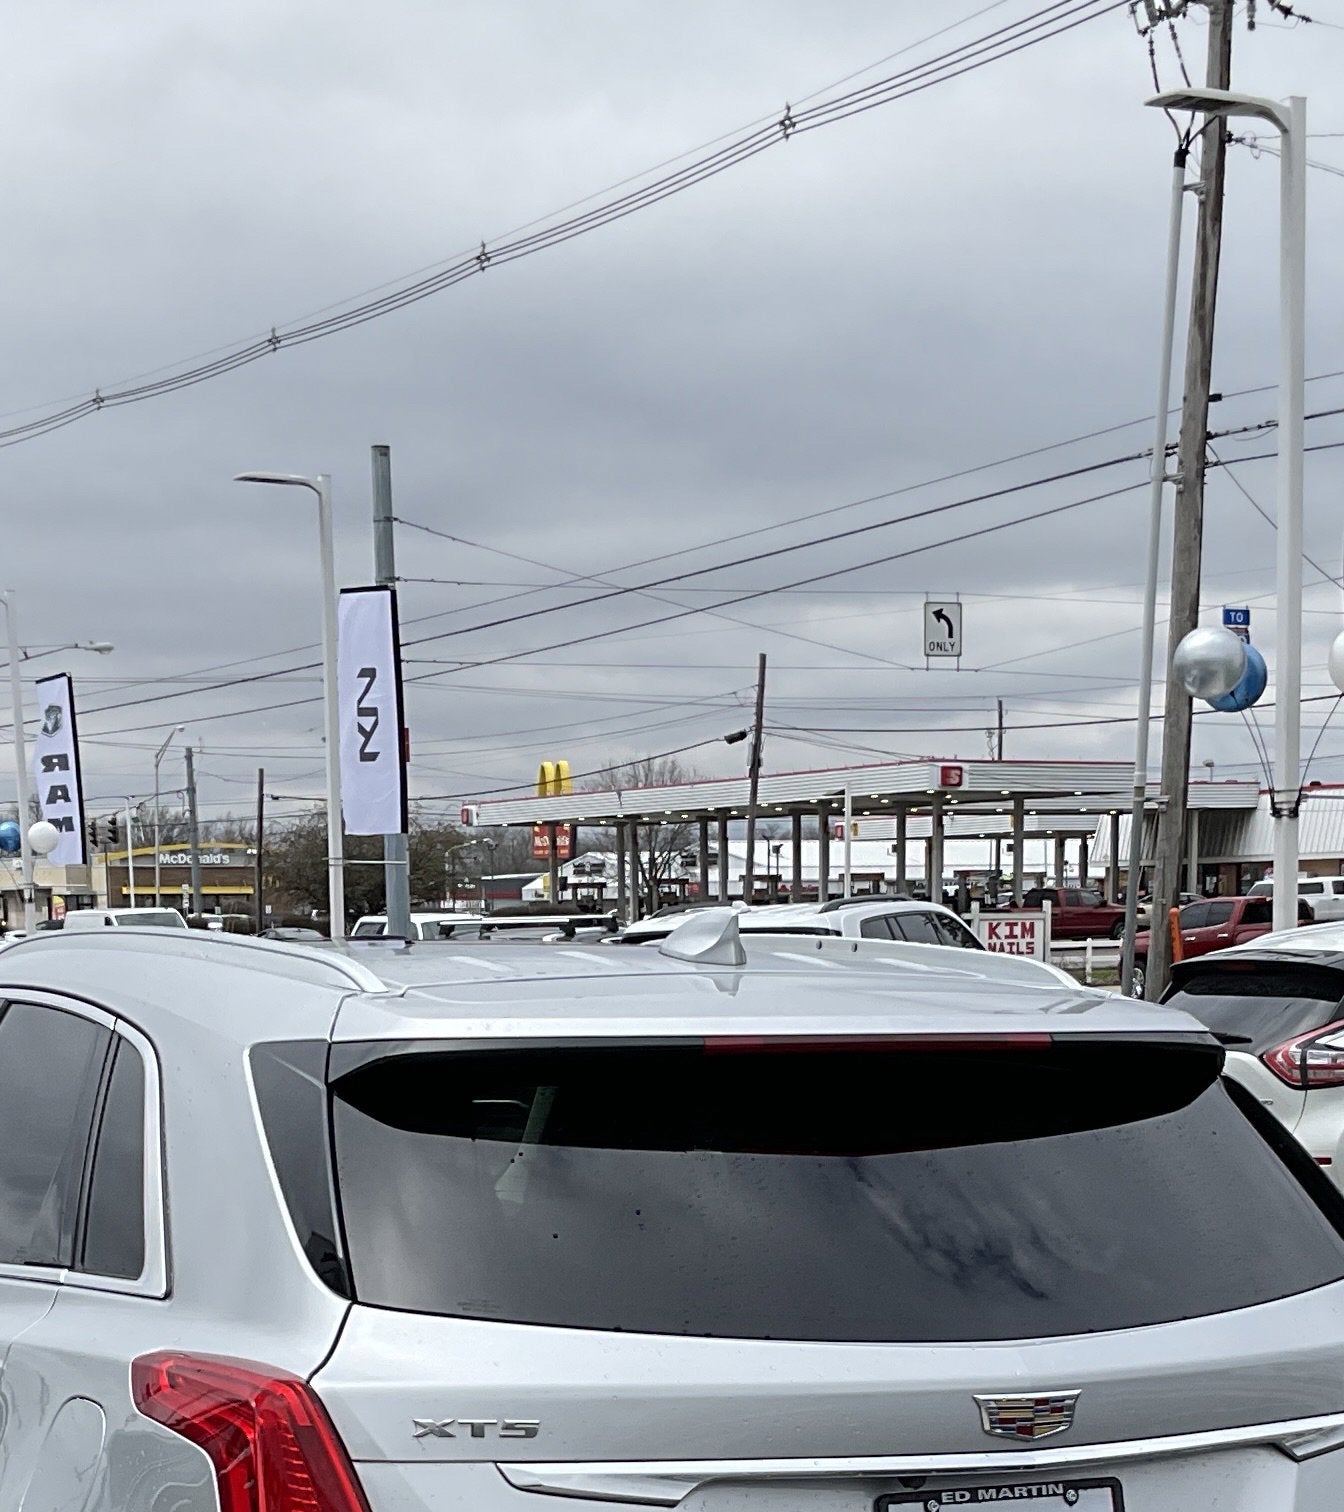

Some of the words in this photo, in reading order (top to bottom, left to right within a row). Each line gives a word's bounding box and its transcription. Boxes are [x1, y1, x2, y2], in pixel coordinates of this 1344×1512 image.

[1230, 611, 1244, 623] TO
[928, 641, 956, 652] ONLY
[987, 921, 1035, 940] KIM
[987, 942, 1035, 955] NAILS
[412, 1418, 541, 1439] XT5
[940, 1491, 971, 1504] ED
[977, 1483, 1065, 1501] MARTIN
